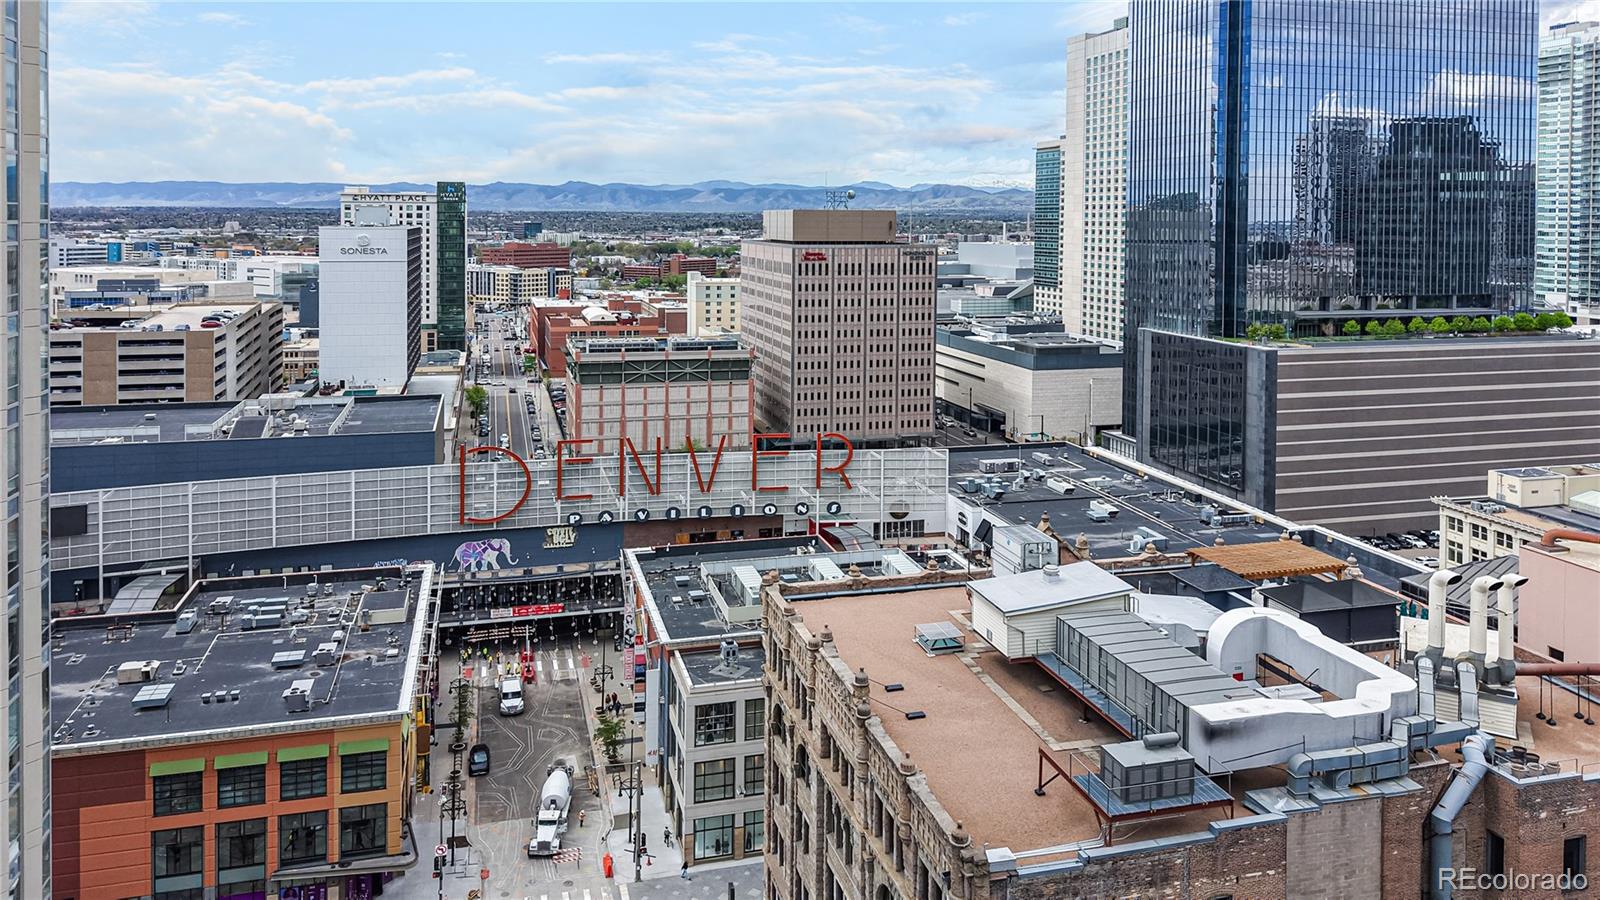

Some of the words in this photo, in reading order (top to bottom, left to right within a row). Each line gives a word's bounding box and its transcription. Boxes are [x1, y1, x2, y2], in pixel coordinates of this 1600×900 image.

[340, 247, 388, 255] SONESTA
[459, 432, 854, 526] DENVER
[569, 502, 841, 524] PAVILIONS
